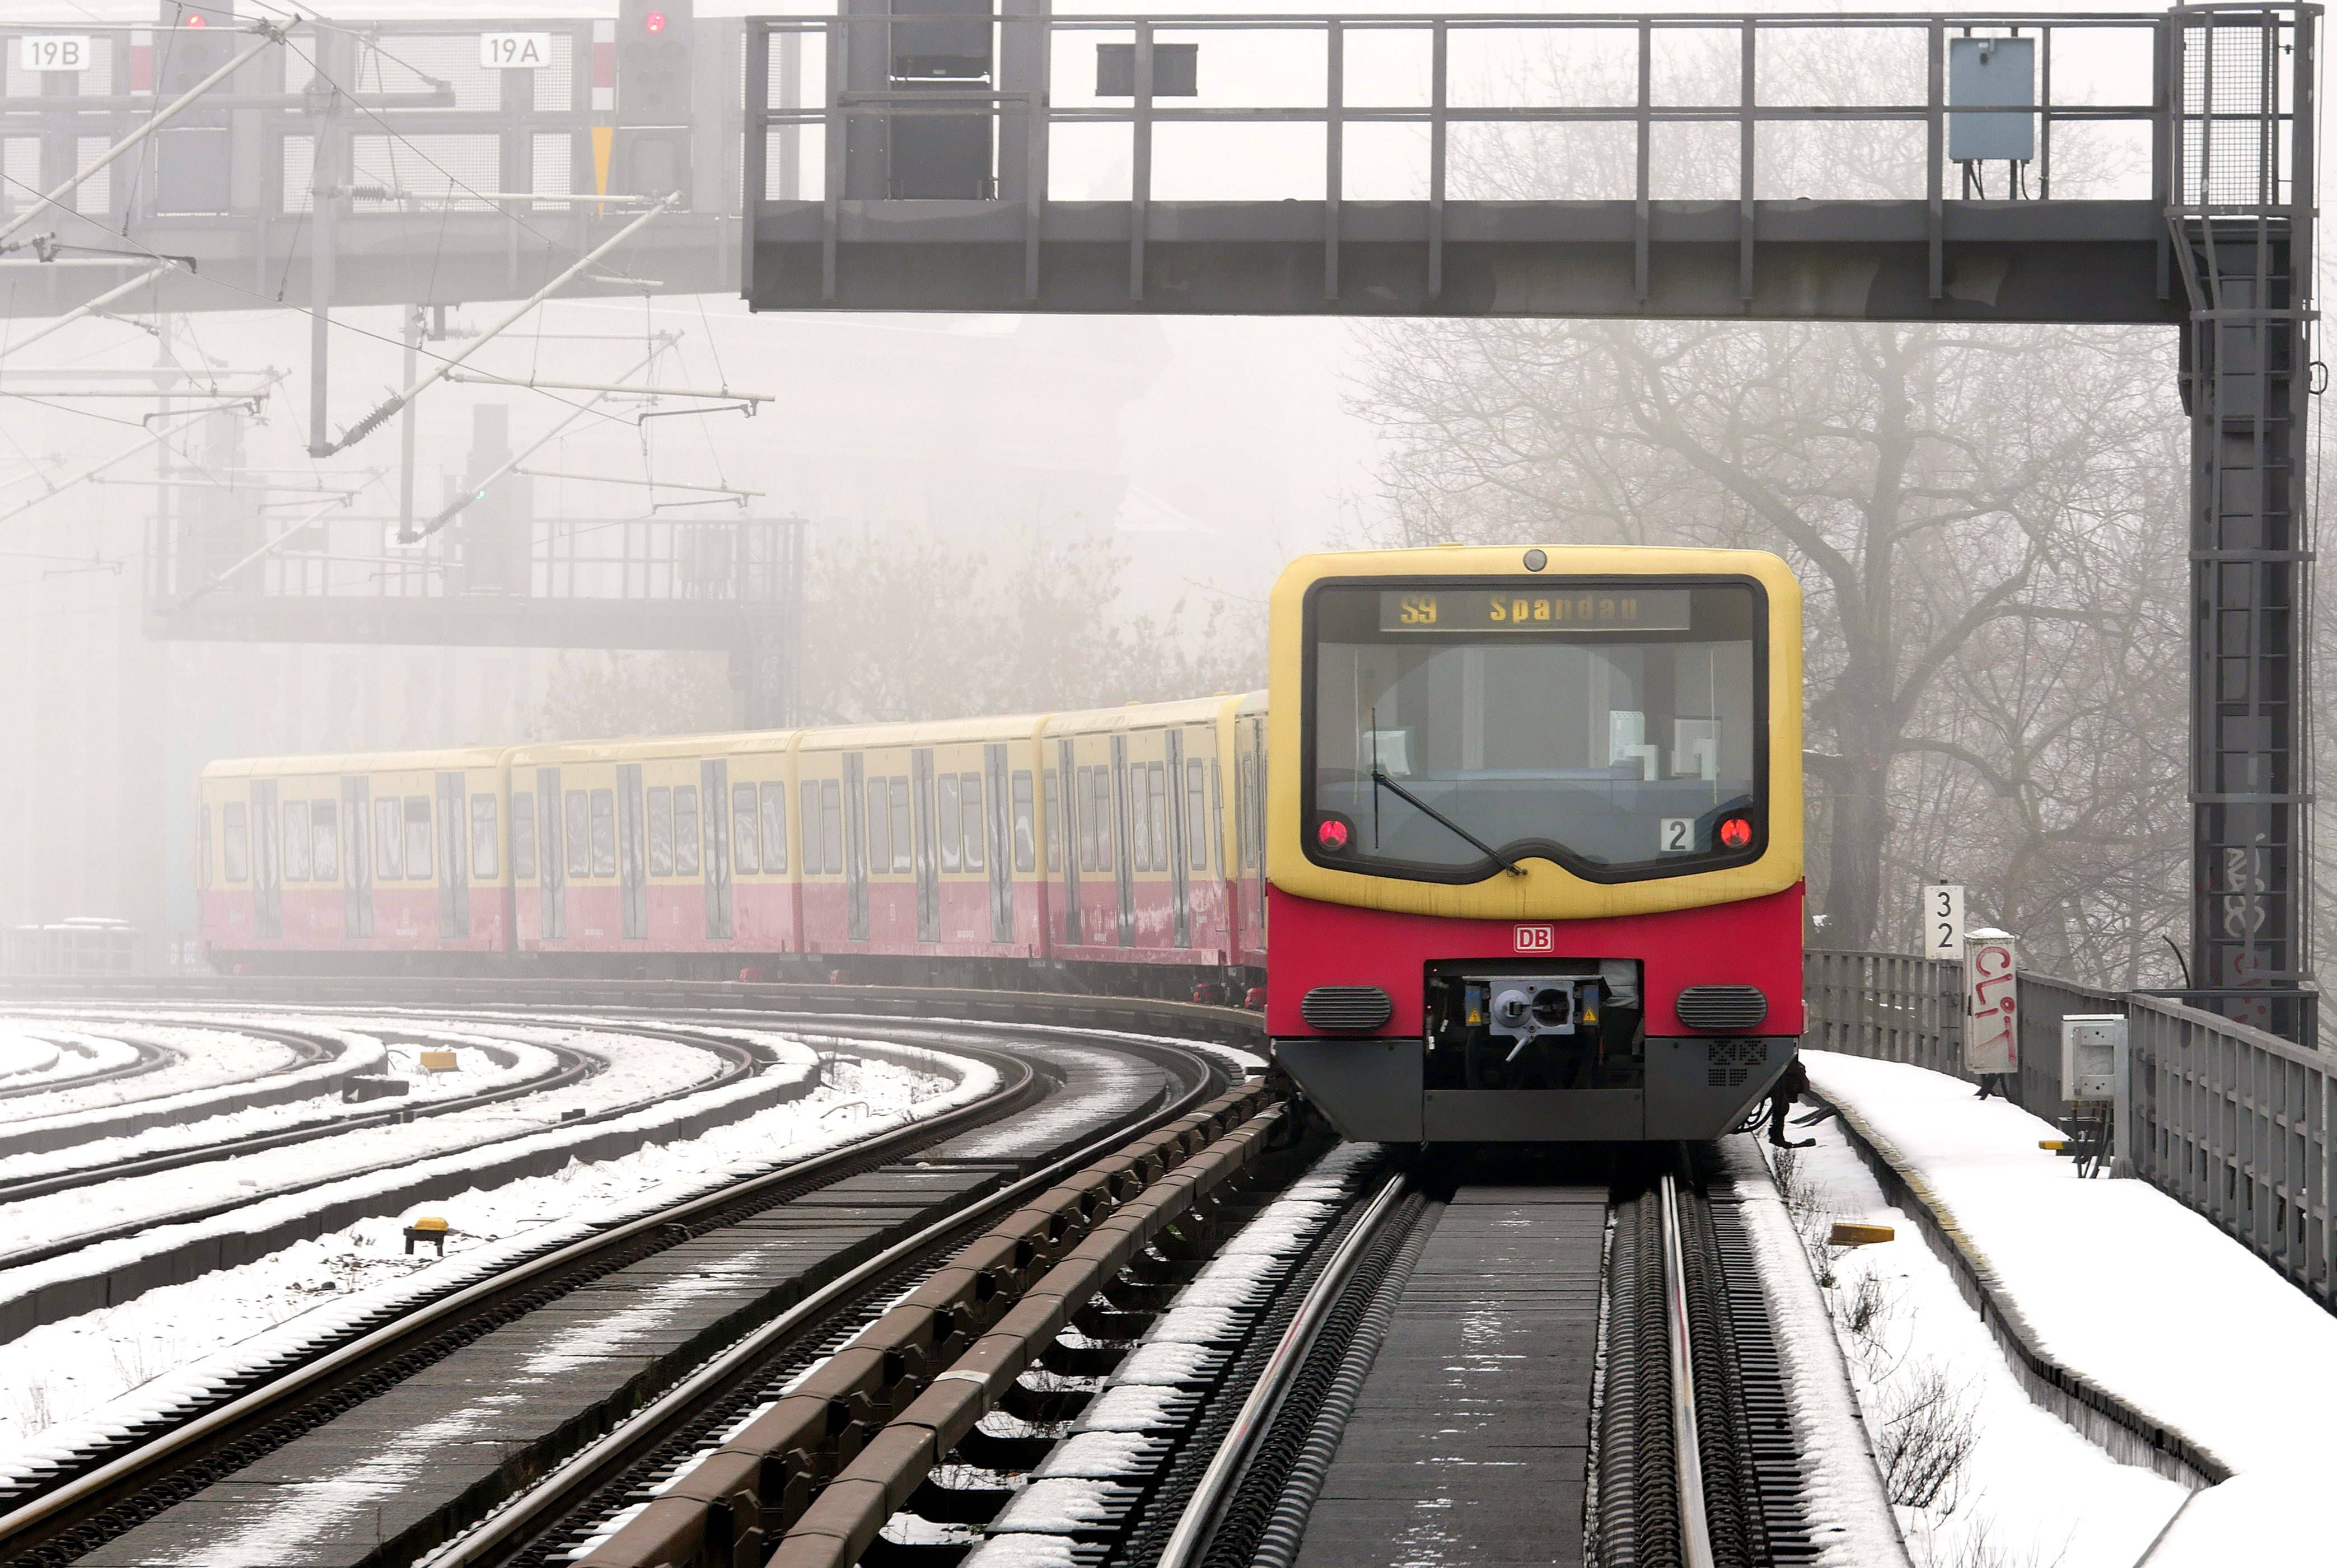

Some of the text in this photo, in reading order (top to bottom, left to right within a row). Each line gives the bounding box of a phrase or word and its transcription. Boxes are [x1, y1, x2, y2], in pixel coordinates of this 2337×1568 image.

[31, 42, 79, 65] 19B
[489, 38, 539, 63] 19A
[1400, 594, 1438, 624] S9
[1670, 821, 1686, 850] 2
[1937, 891, 1952, 918] 3
[1520, 929, 1549, 948] DB
[1938, 923, 1953, 948] 2
